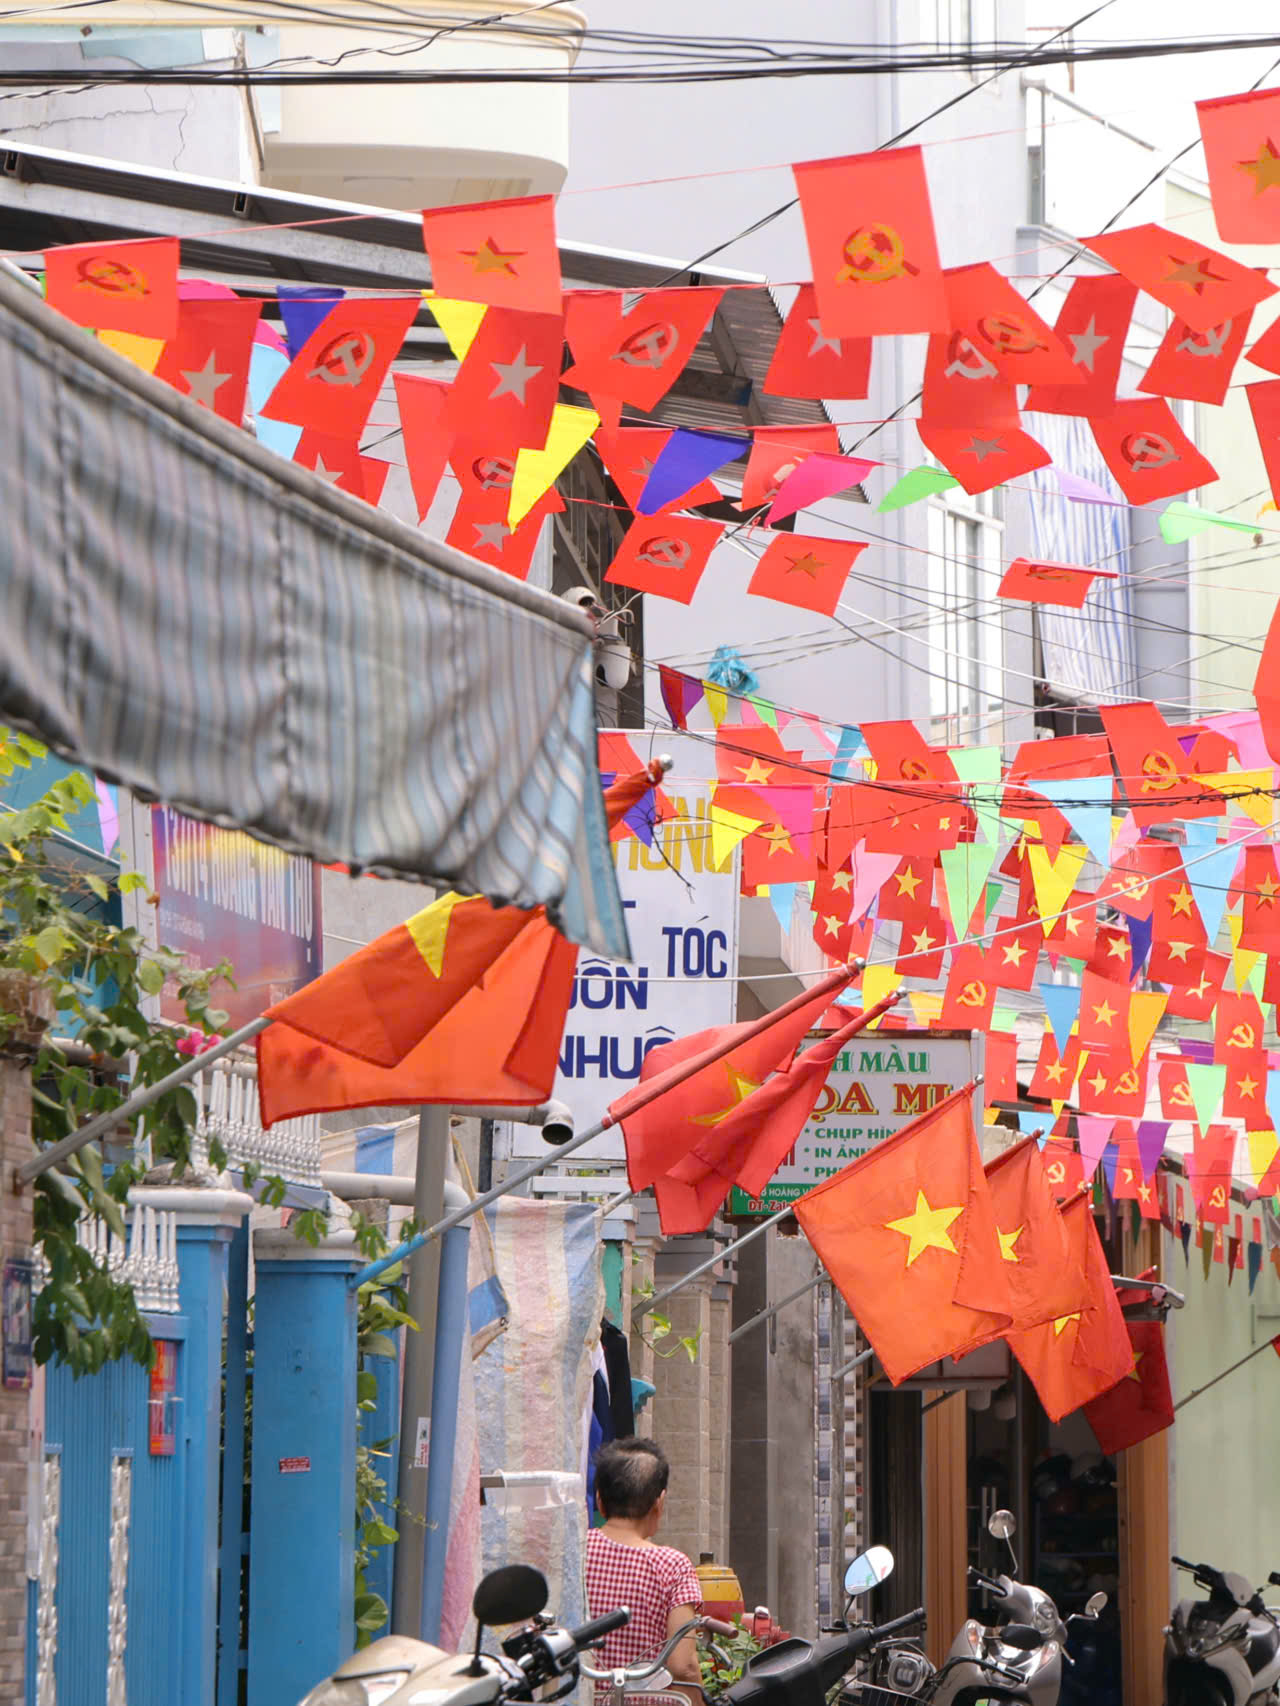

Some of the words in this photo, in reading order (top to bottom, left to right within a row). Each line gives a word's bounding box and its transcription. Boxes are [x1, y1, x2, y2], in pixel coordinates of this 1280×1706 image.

[662, 916, 728, 979] TÓC
[859, 1044, 928, 1073] MÀU
[814, 1127, 863, 1142] CHỤP
[815, 1148, 832, 1158] IN
